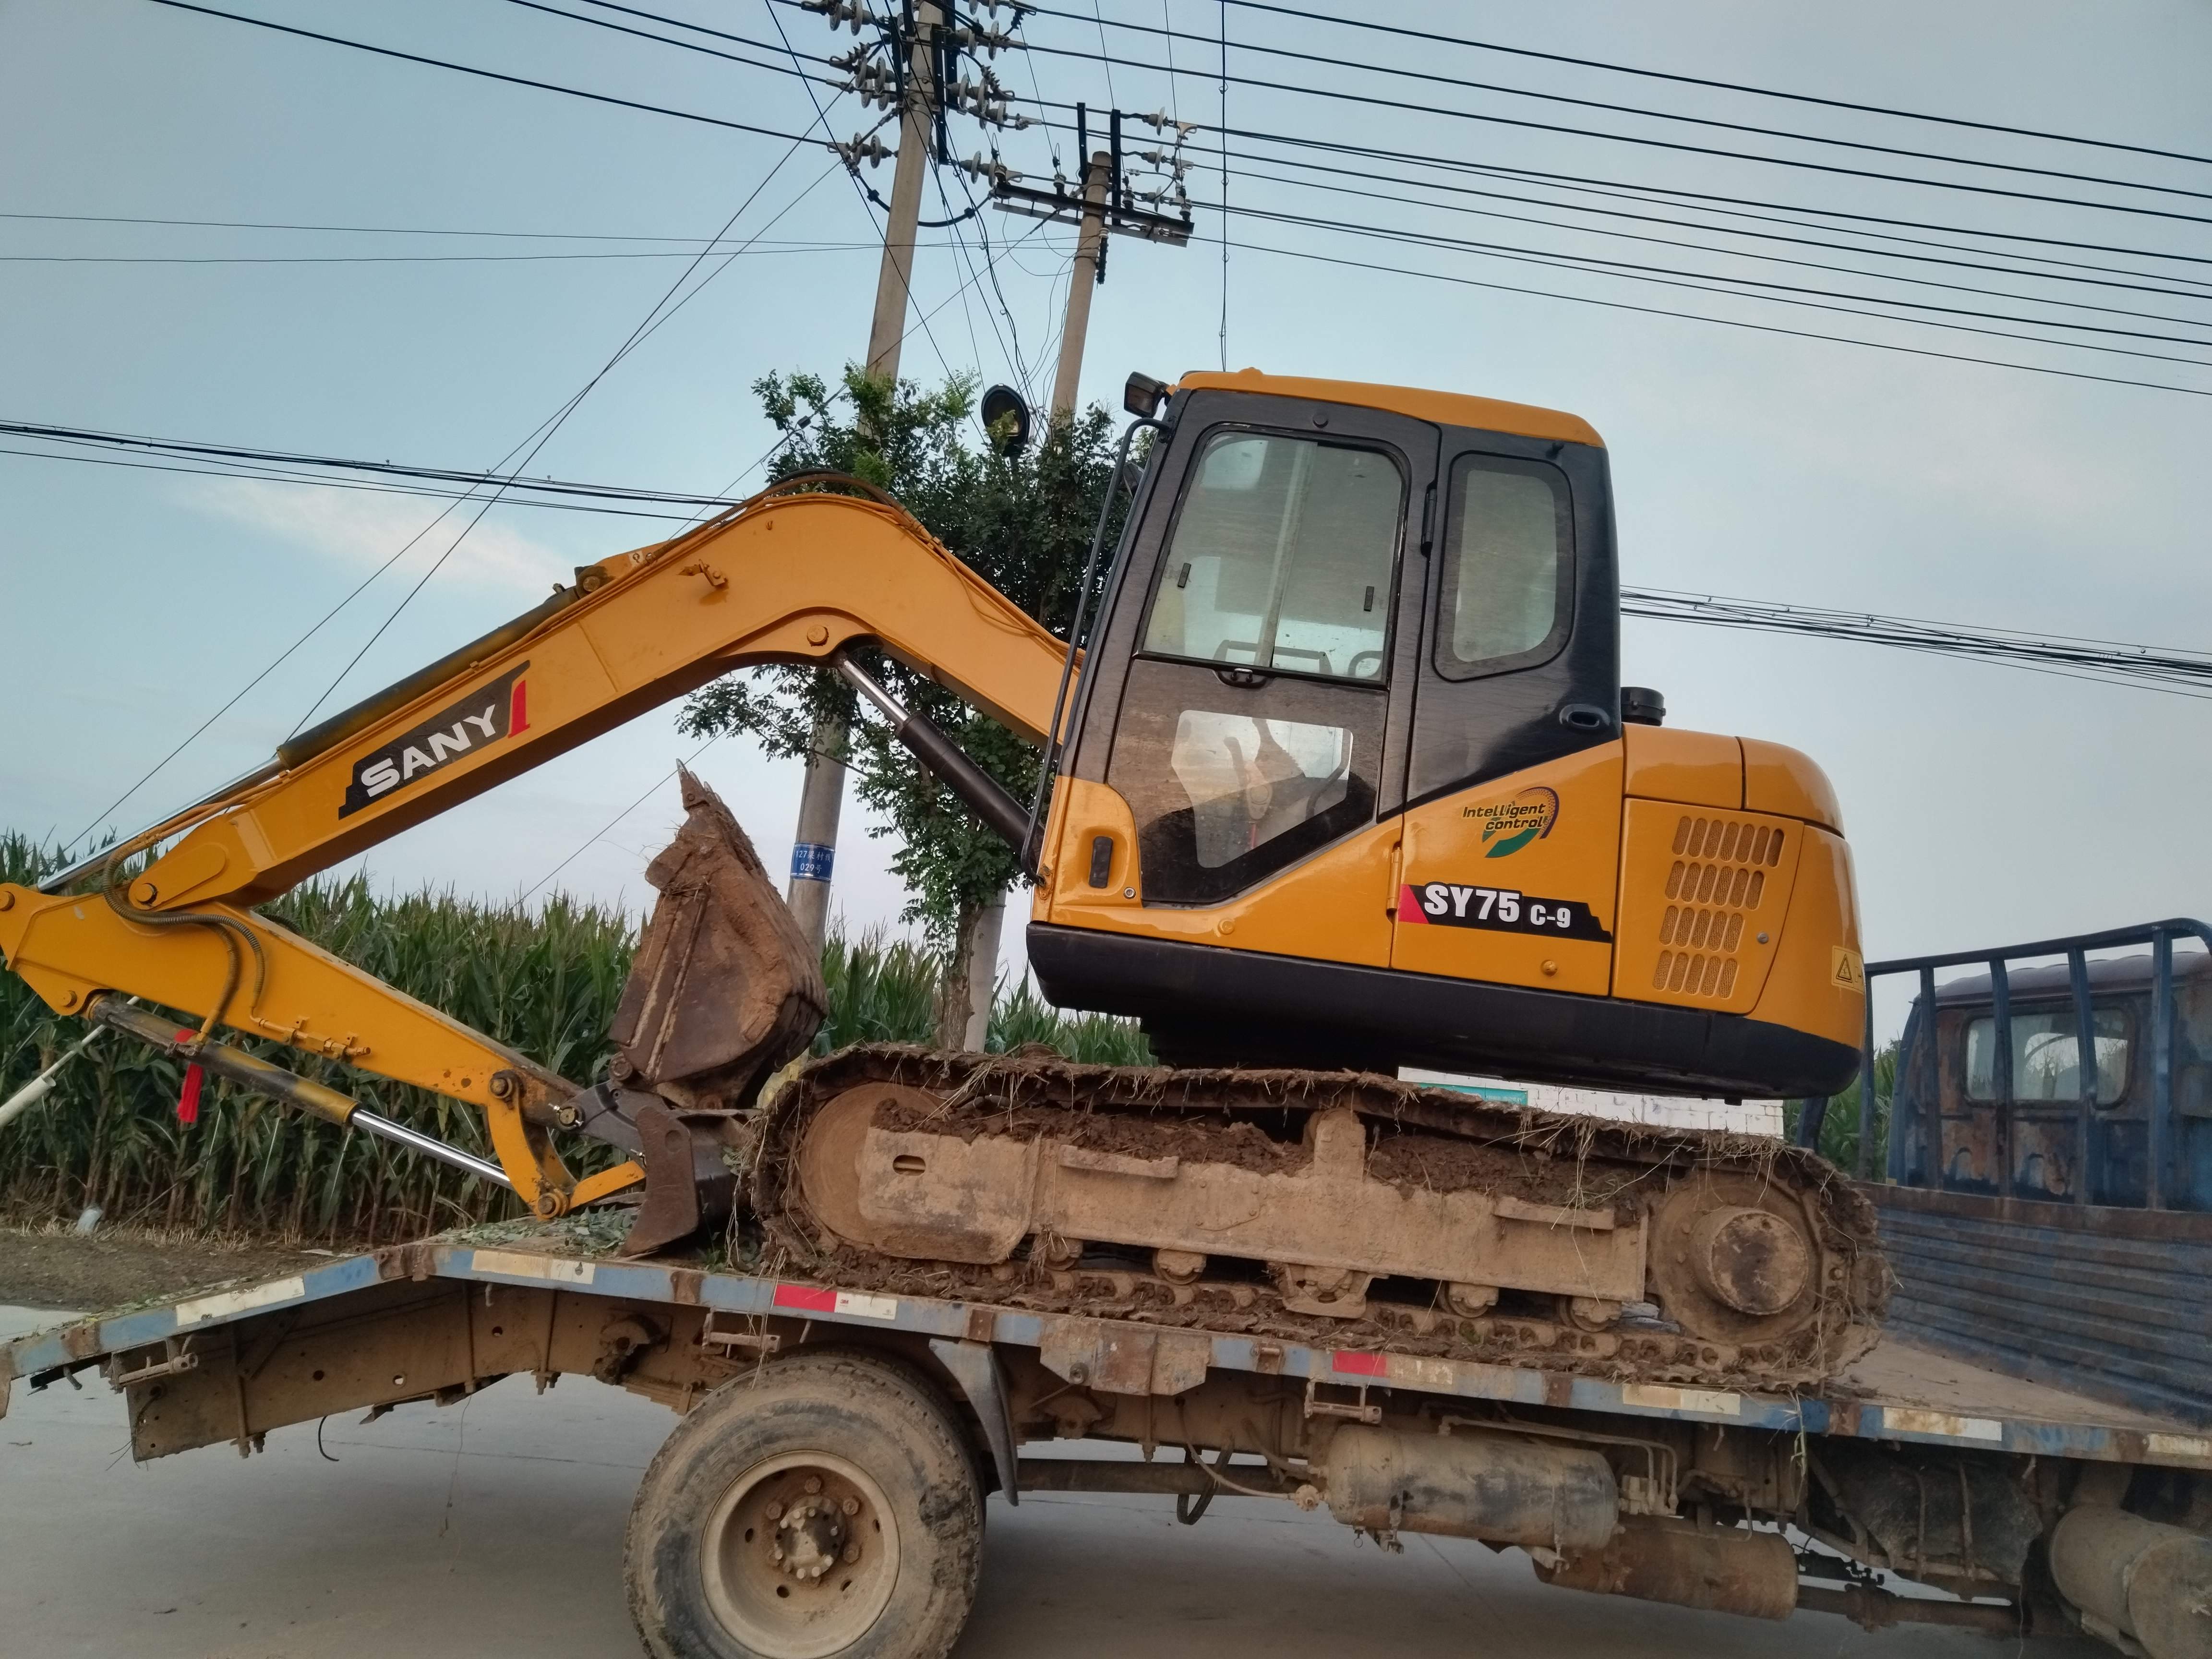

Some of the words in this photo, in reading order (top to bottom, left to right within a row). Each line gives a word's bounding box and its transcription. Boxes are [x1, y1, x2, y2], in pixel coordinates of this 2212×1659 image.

[361, 704, 496, 798] SANY
[1463, 802, 1546, 819] Intelligent
[1485, 816, 1544, 831] control
[800, 863, 822, 874] 029号
[1424, 884, 1520, 923] SY75
[1530, 904, 1571, 928] C-9
